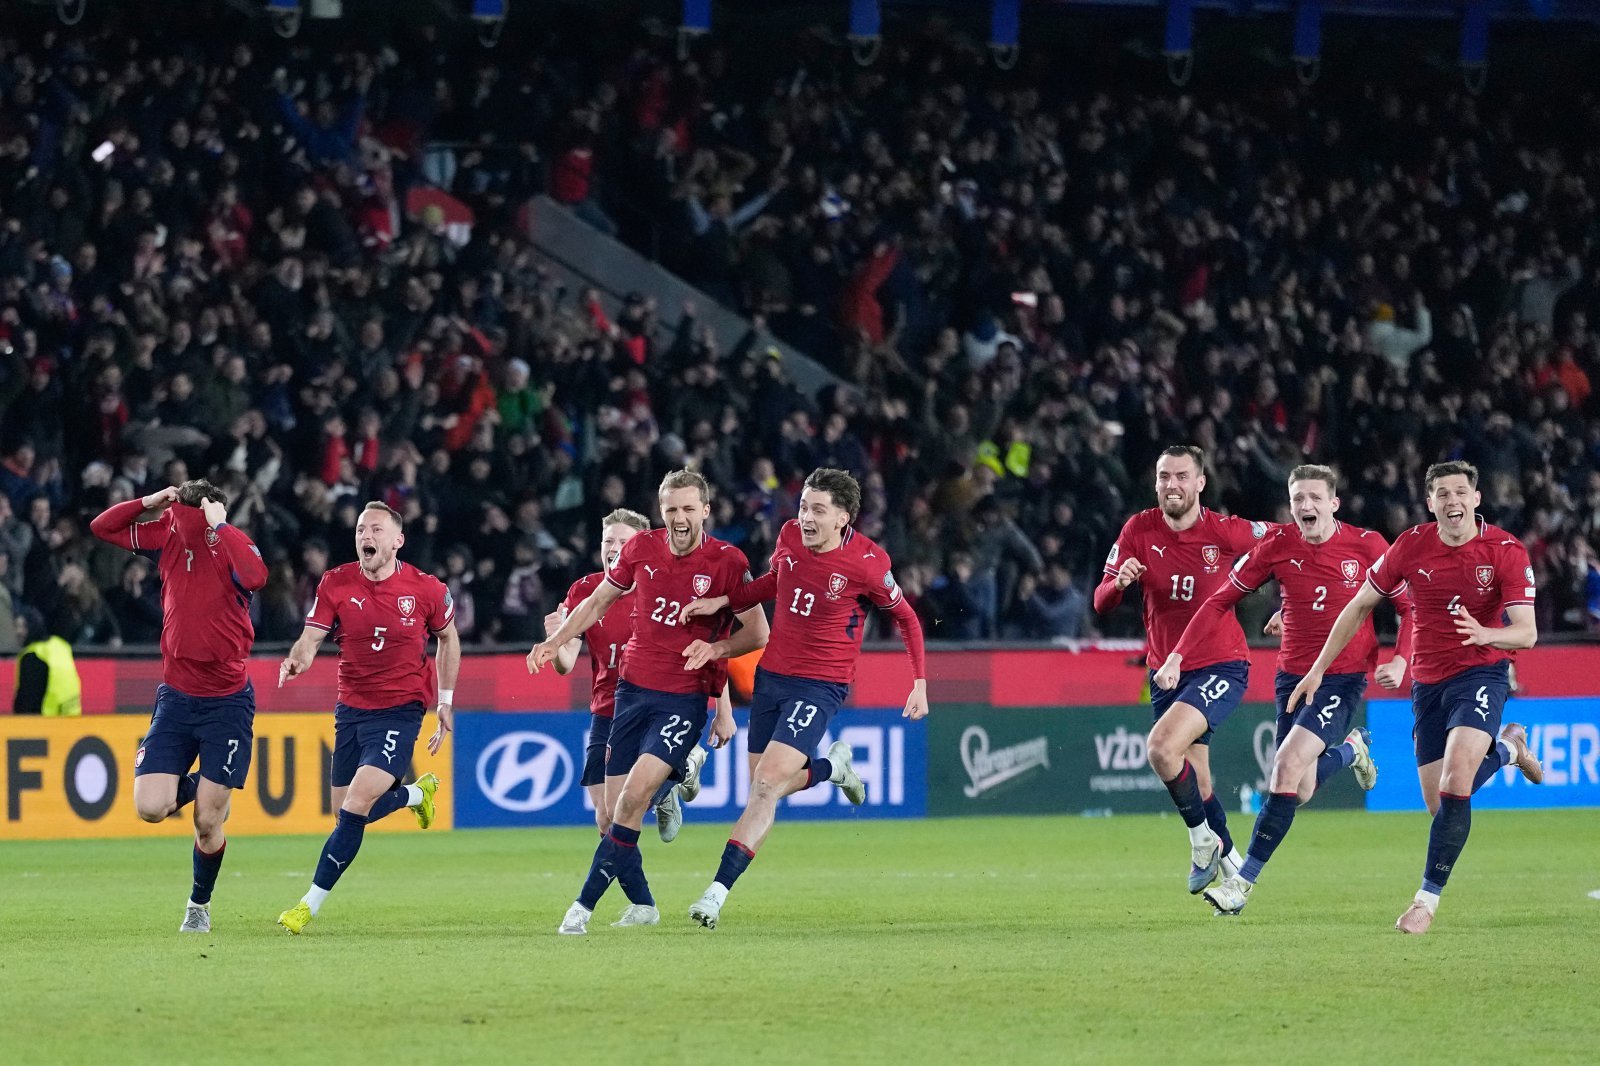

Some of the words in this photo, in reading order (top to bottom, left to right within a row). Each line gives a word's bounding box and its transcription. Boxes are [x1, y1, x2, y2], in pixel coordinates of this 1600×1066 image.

[184, 548, 194, 572] 7
[1169, 574, 1195, 601] 19
[1312, 585, 1327, 611] 2
[650, 596, 681, 627] 22
[789, 587, 815, 617] 13
[1446, 595, 1461, 615] 4
[371, 626, 388, 652] 5
[607, 643, 627, 669] 1
[1197, 674, 1230, 700] 19
[1475, 685, 1489, 709] 4
[786, 700, 818, 728] 13
[1320, 695, 1341, 719] 2
[383, 730, 400, 752] 5
[659, 714, 692, 746] 22
[226, 739, 239, 765] 7
[1094, 726, 1149, 770] VŽD
[1435, 863, 1450, 871] CZE
